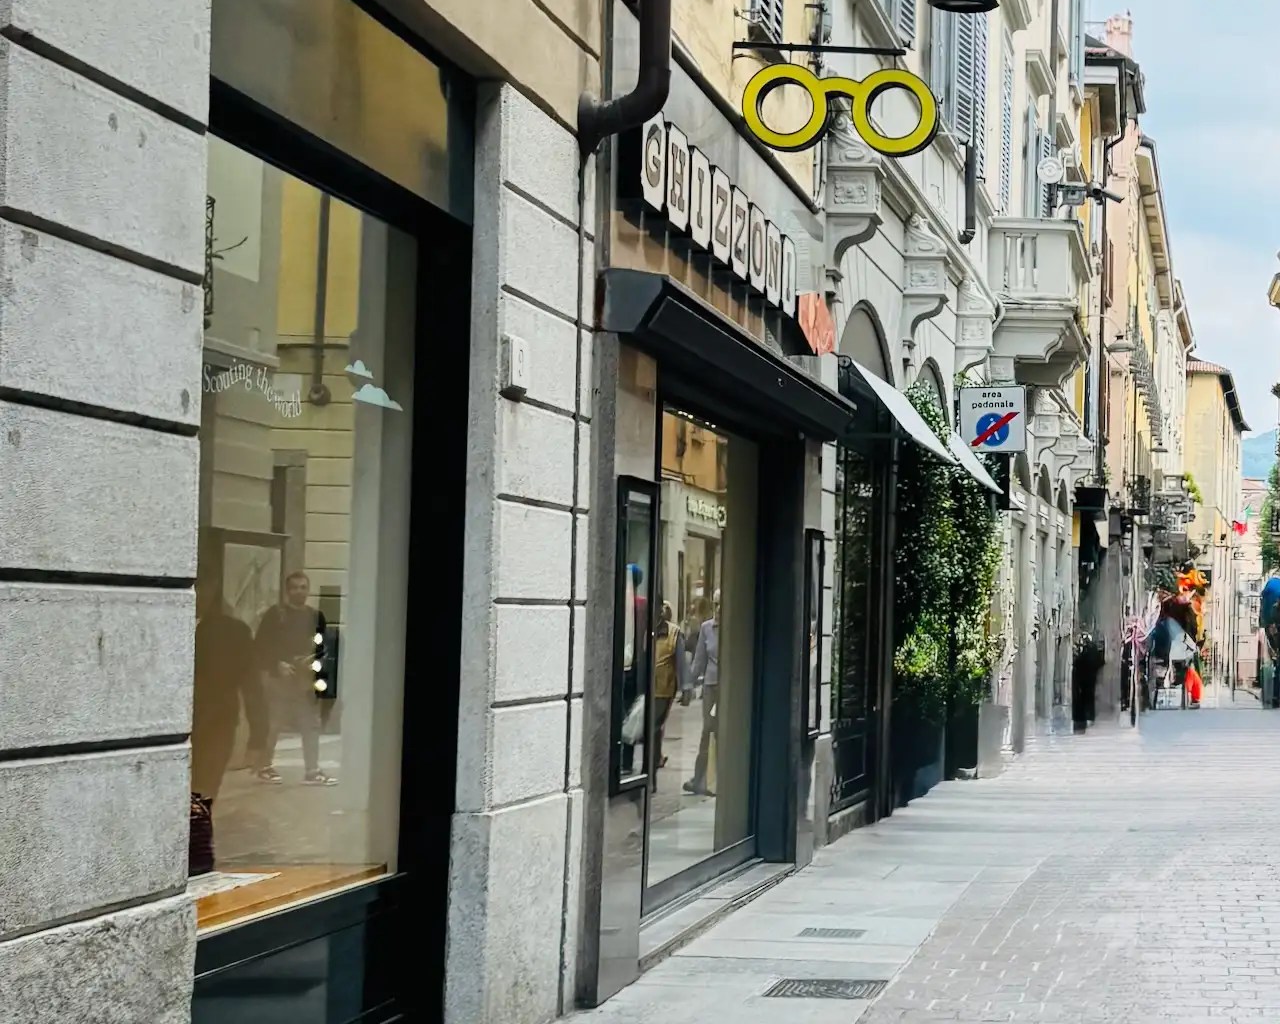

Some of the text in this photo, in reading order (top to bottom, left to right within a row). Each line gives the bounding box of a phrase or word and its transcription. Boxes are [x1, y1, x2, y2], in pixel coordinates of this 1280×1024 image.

[643, 120, 794, 306] GHIZZONI
[202, 358, 302, 418] Scouting the world
[972, 400, 1014, 410] pedonale
